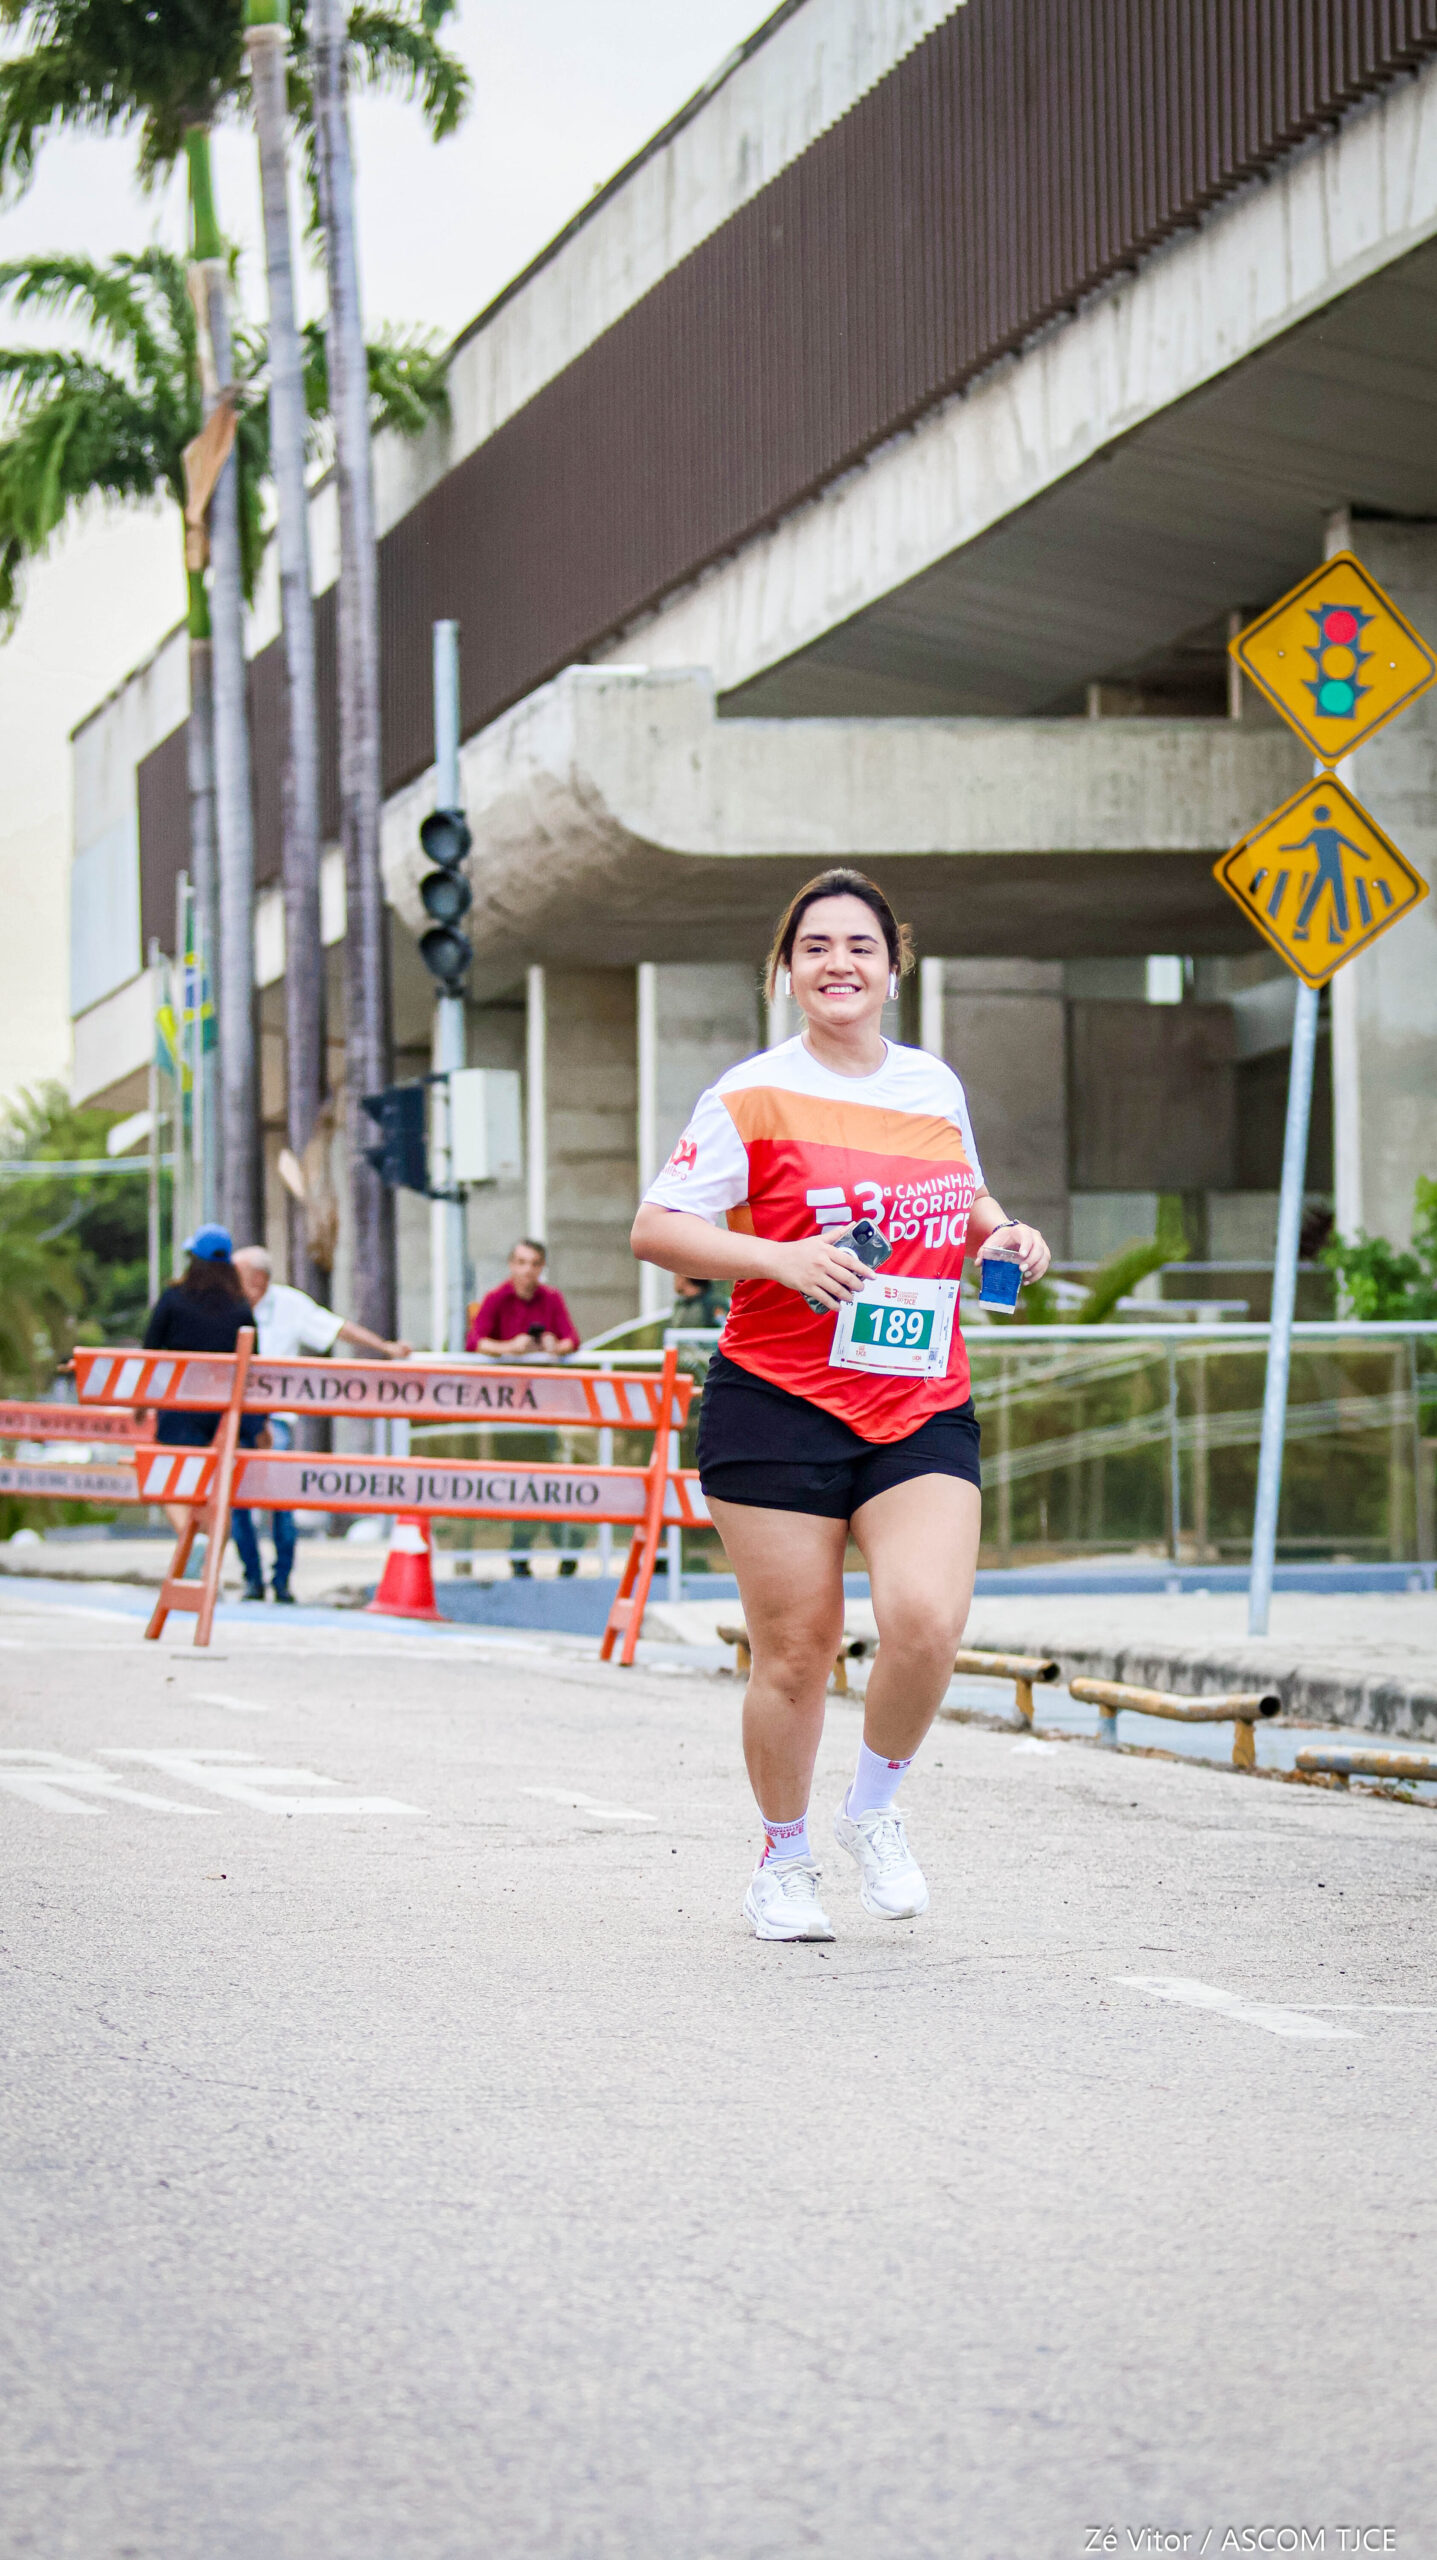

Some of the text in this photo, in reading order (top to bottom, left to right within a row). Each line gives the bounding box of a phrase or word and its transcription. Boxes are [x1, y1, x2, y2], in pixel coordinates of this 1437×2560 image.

[889, 1189, 976, 1220] /CORRID
[890, 1219, 920, 1243] DO
[869, 1308, 924, 1346] 189
[246, 1373, 538, 1410] ESTADO DO CEARÁ
[301, 1469, 599, 1505] PODER JUDICIÁRIO
[780, 1825, 805, 1839] TJCE
